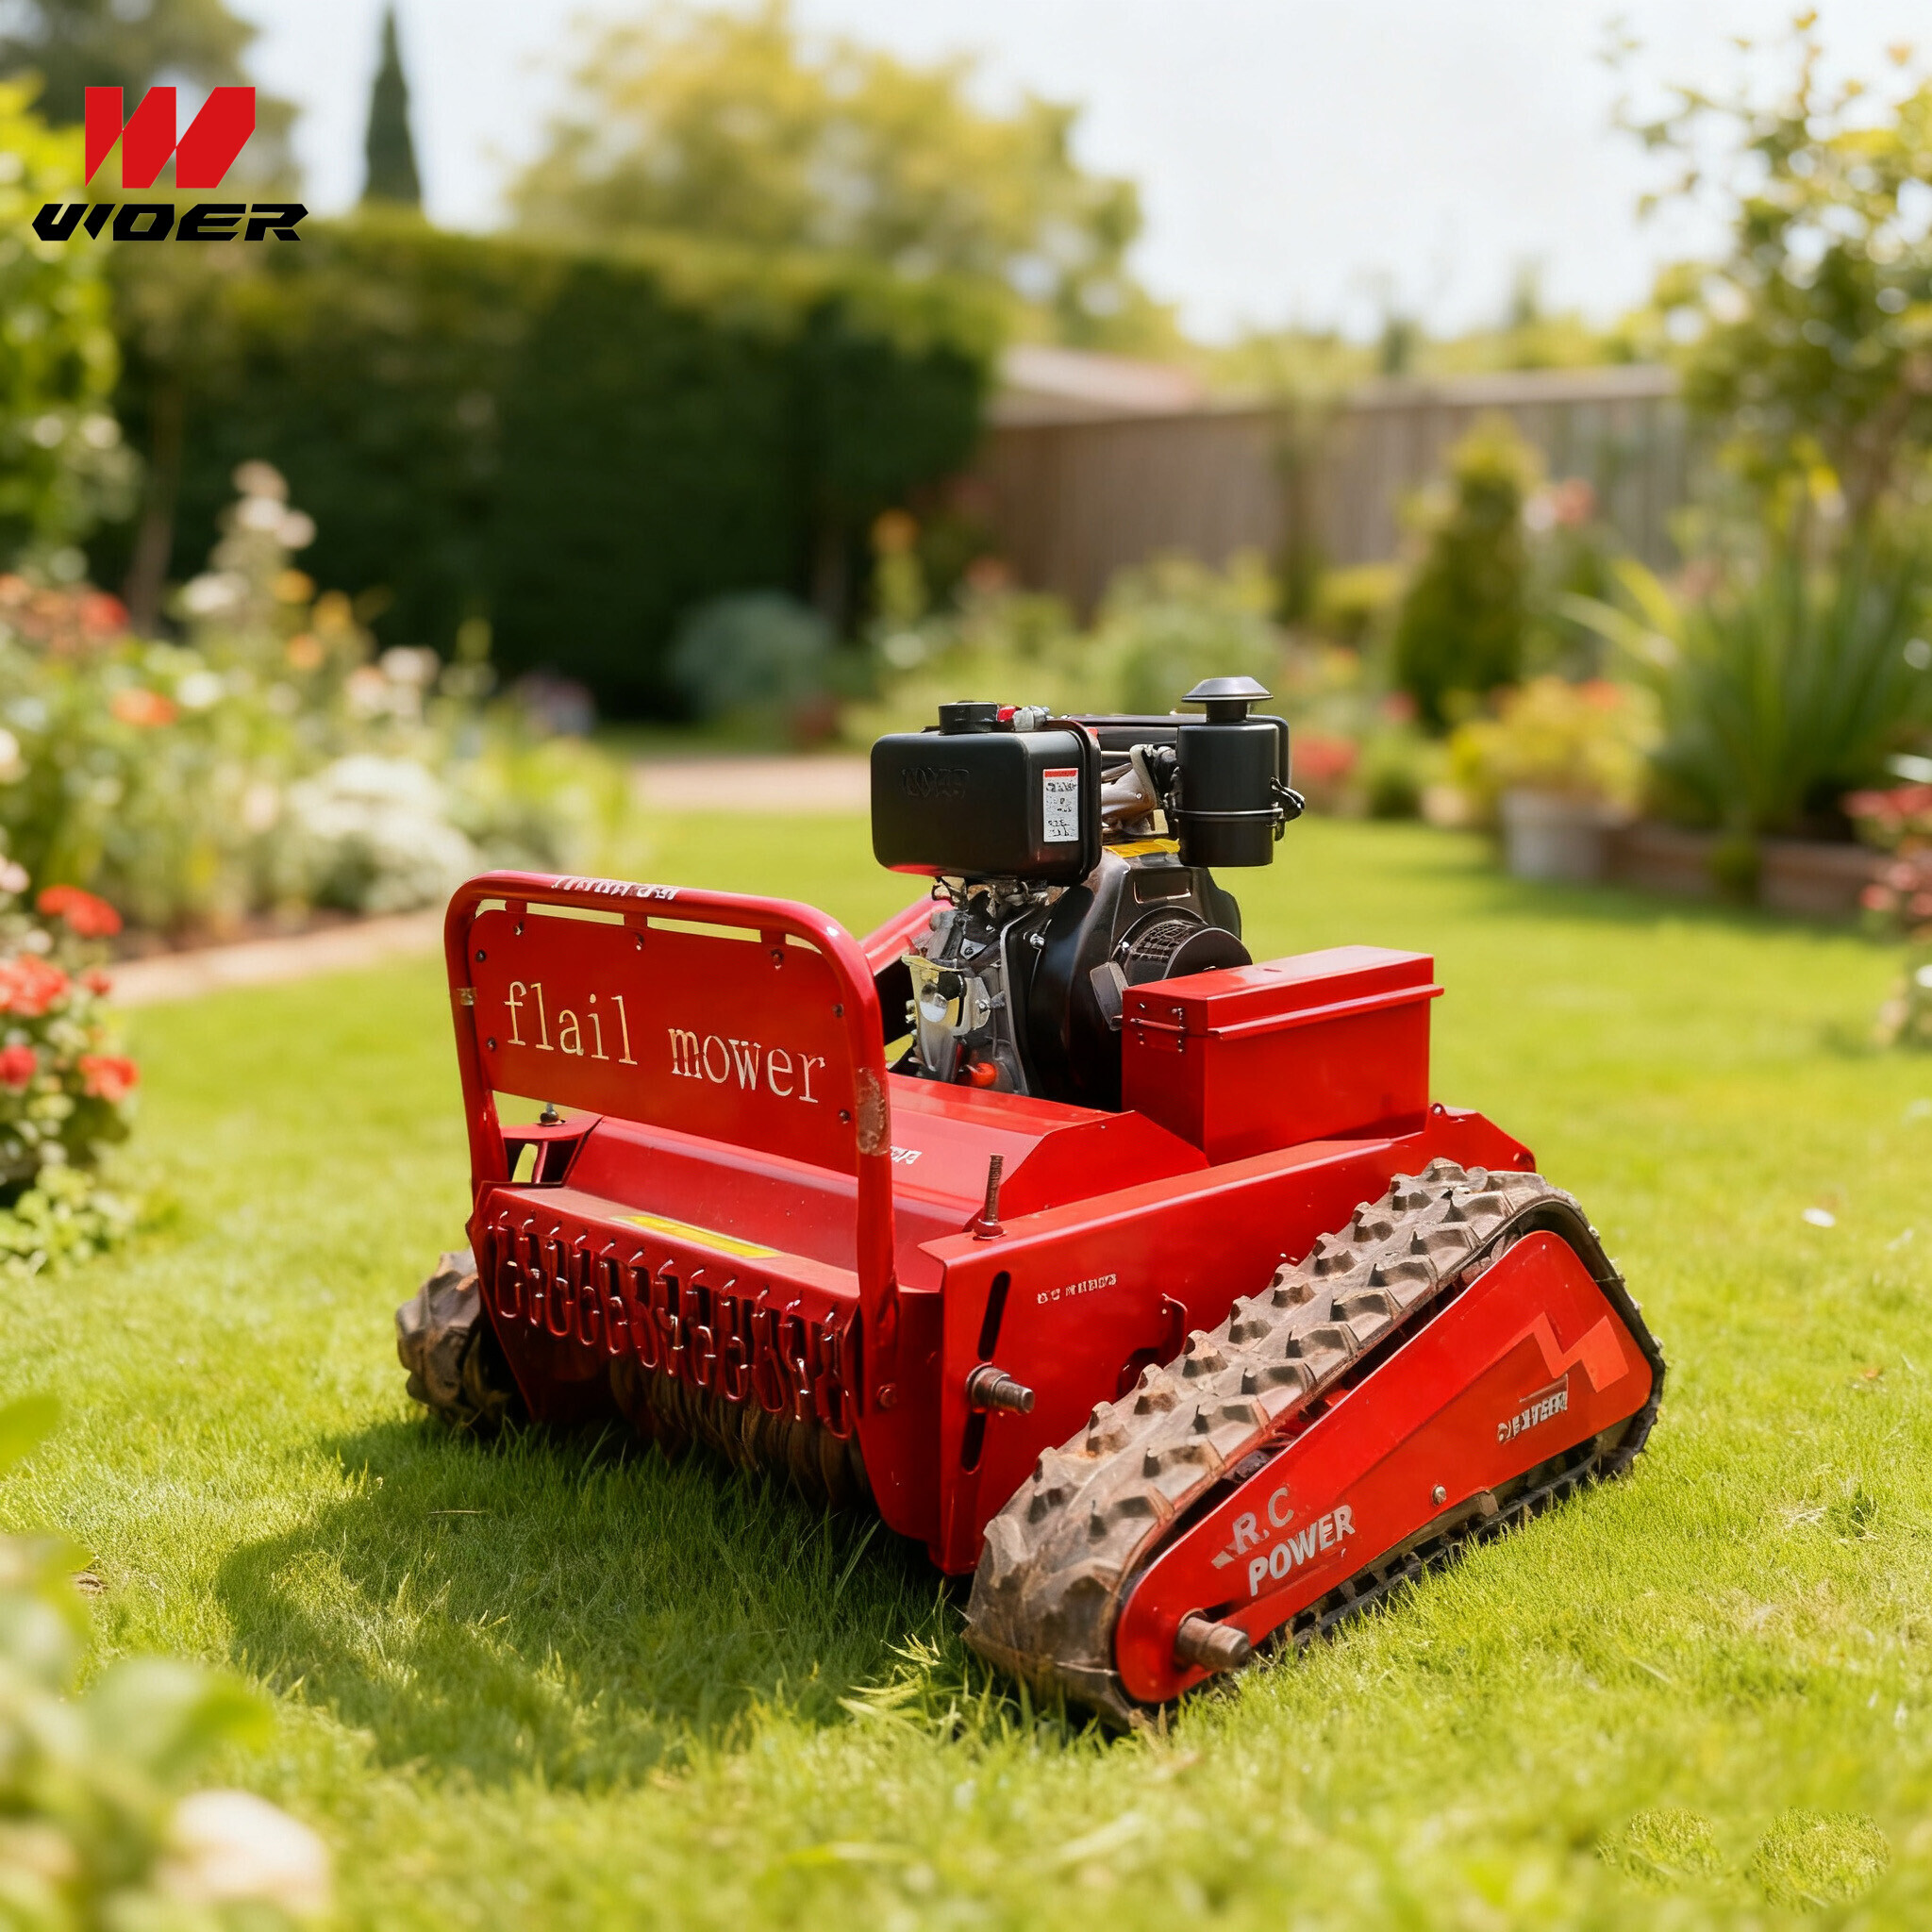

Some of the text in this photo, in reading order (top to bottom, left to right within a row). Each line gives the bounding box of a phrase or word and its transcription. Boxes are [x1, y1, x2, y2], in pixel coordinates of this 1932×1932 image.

[503, 980, 825, 1105] flail mower
[1248, 1504, 1356, 1597] POWER
